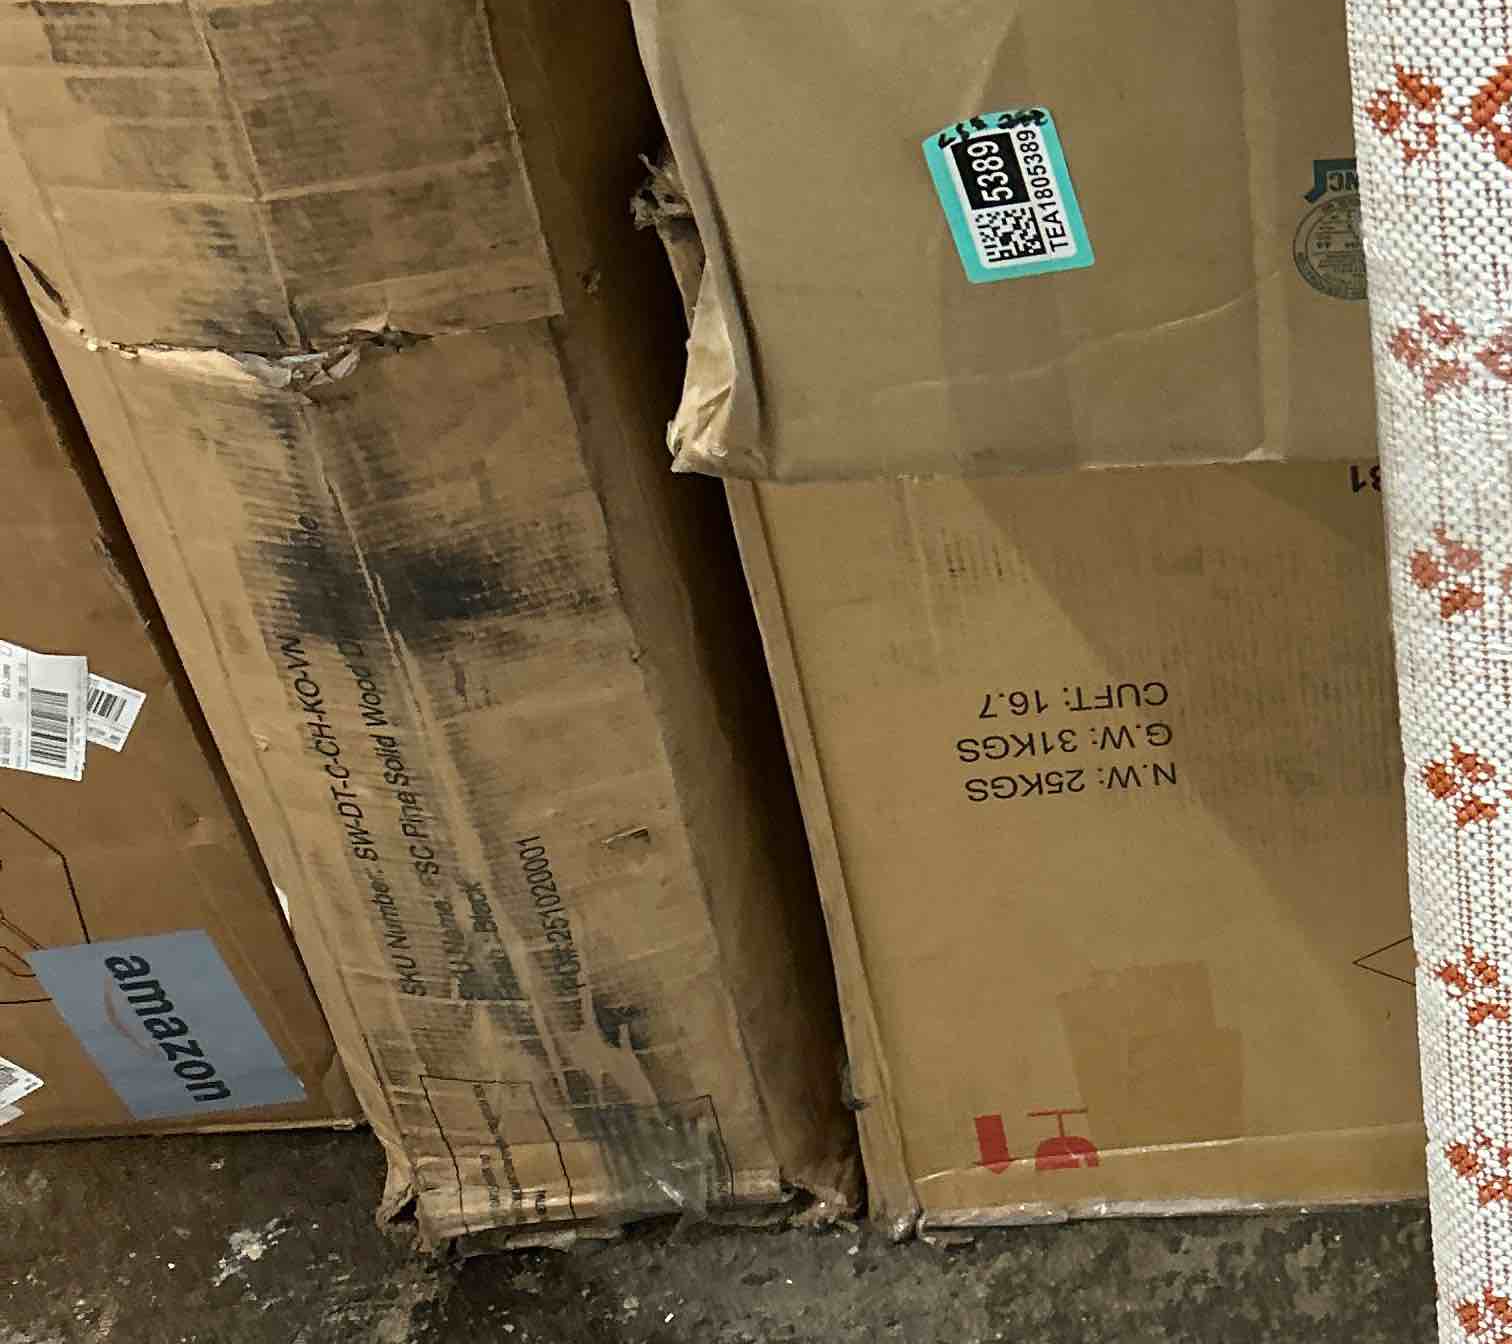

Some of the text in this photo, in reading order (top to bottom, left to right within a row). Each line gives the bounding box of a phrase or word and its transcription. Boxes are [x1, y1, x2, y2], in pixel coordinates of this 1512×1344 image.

[967, 140, 1014, 202] 5389
[1016, 129, 1070, 253] TEA1805389
[978, 682, 1169, 719] CUFT: 16.7
[368, 733, 409, 787] Solid
[956, 722, 1173, 763] G.W: 31KGS
[965, 761, 1177, 802] N.W: 25KGS
[104, 955, 231, 1102] amazon
